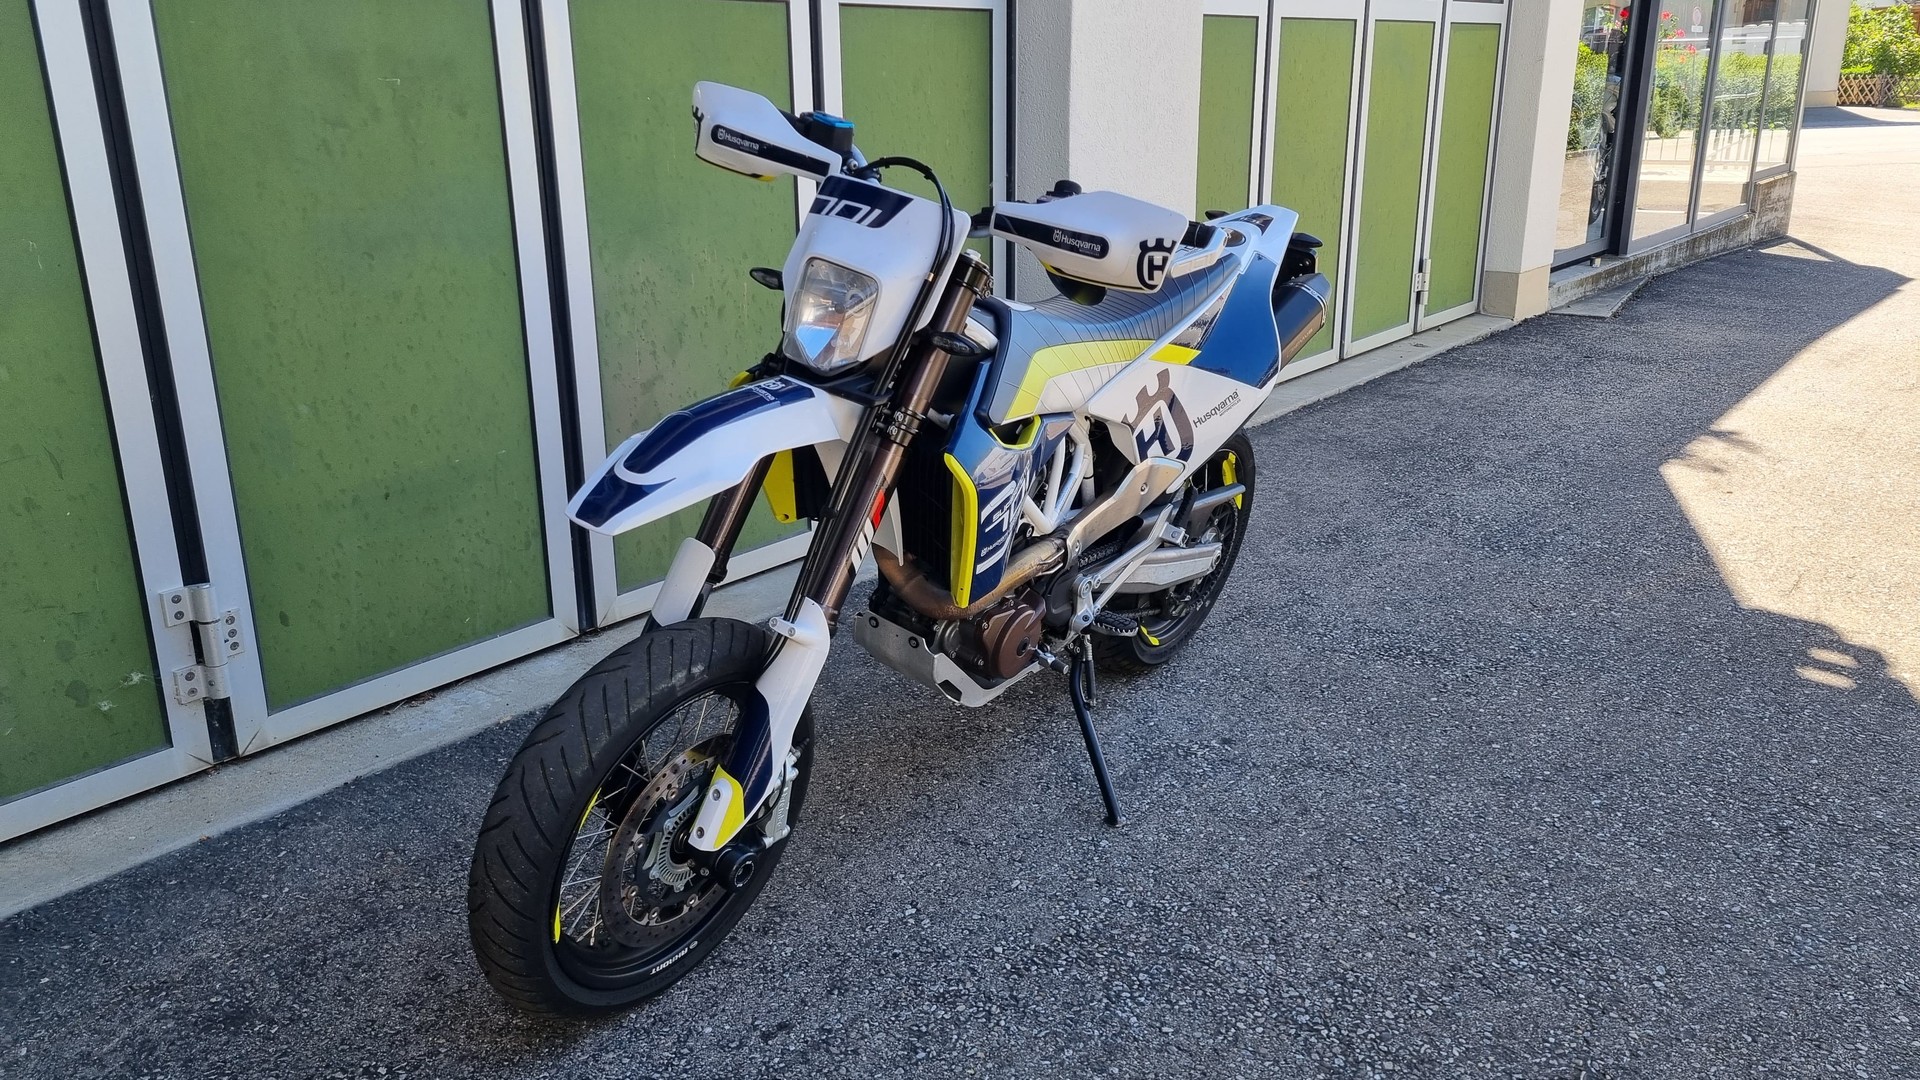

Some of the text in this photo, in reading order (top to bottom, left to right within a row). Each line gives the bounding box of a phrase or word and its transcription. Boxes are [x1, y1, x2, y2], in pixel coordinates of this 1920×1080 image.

[725, 132, 760, 151] Husqvarna
[1061, 235, 1102, 253] Husqvarna
[1192, 390, 1239, 428] Husqvarna
